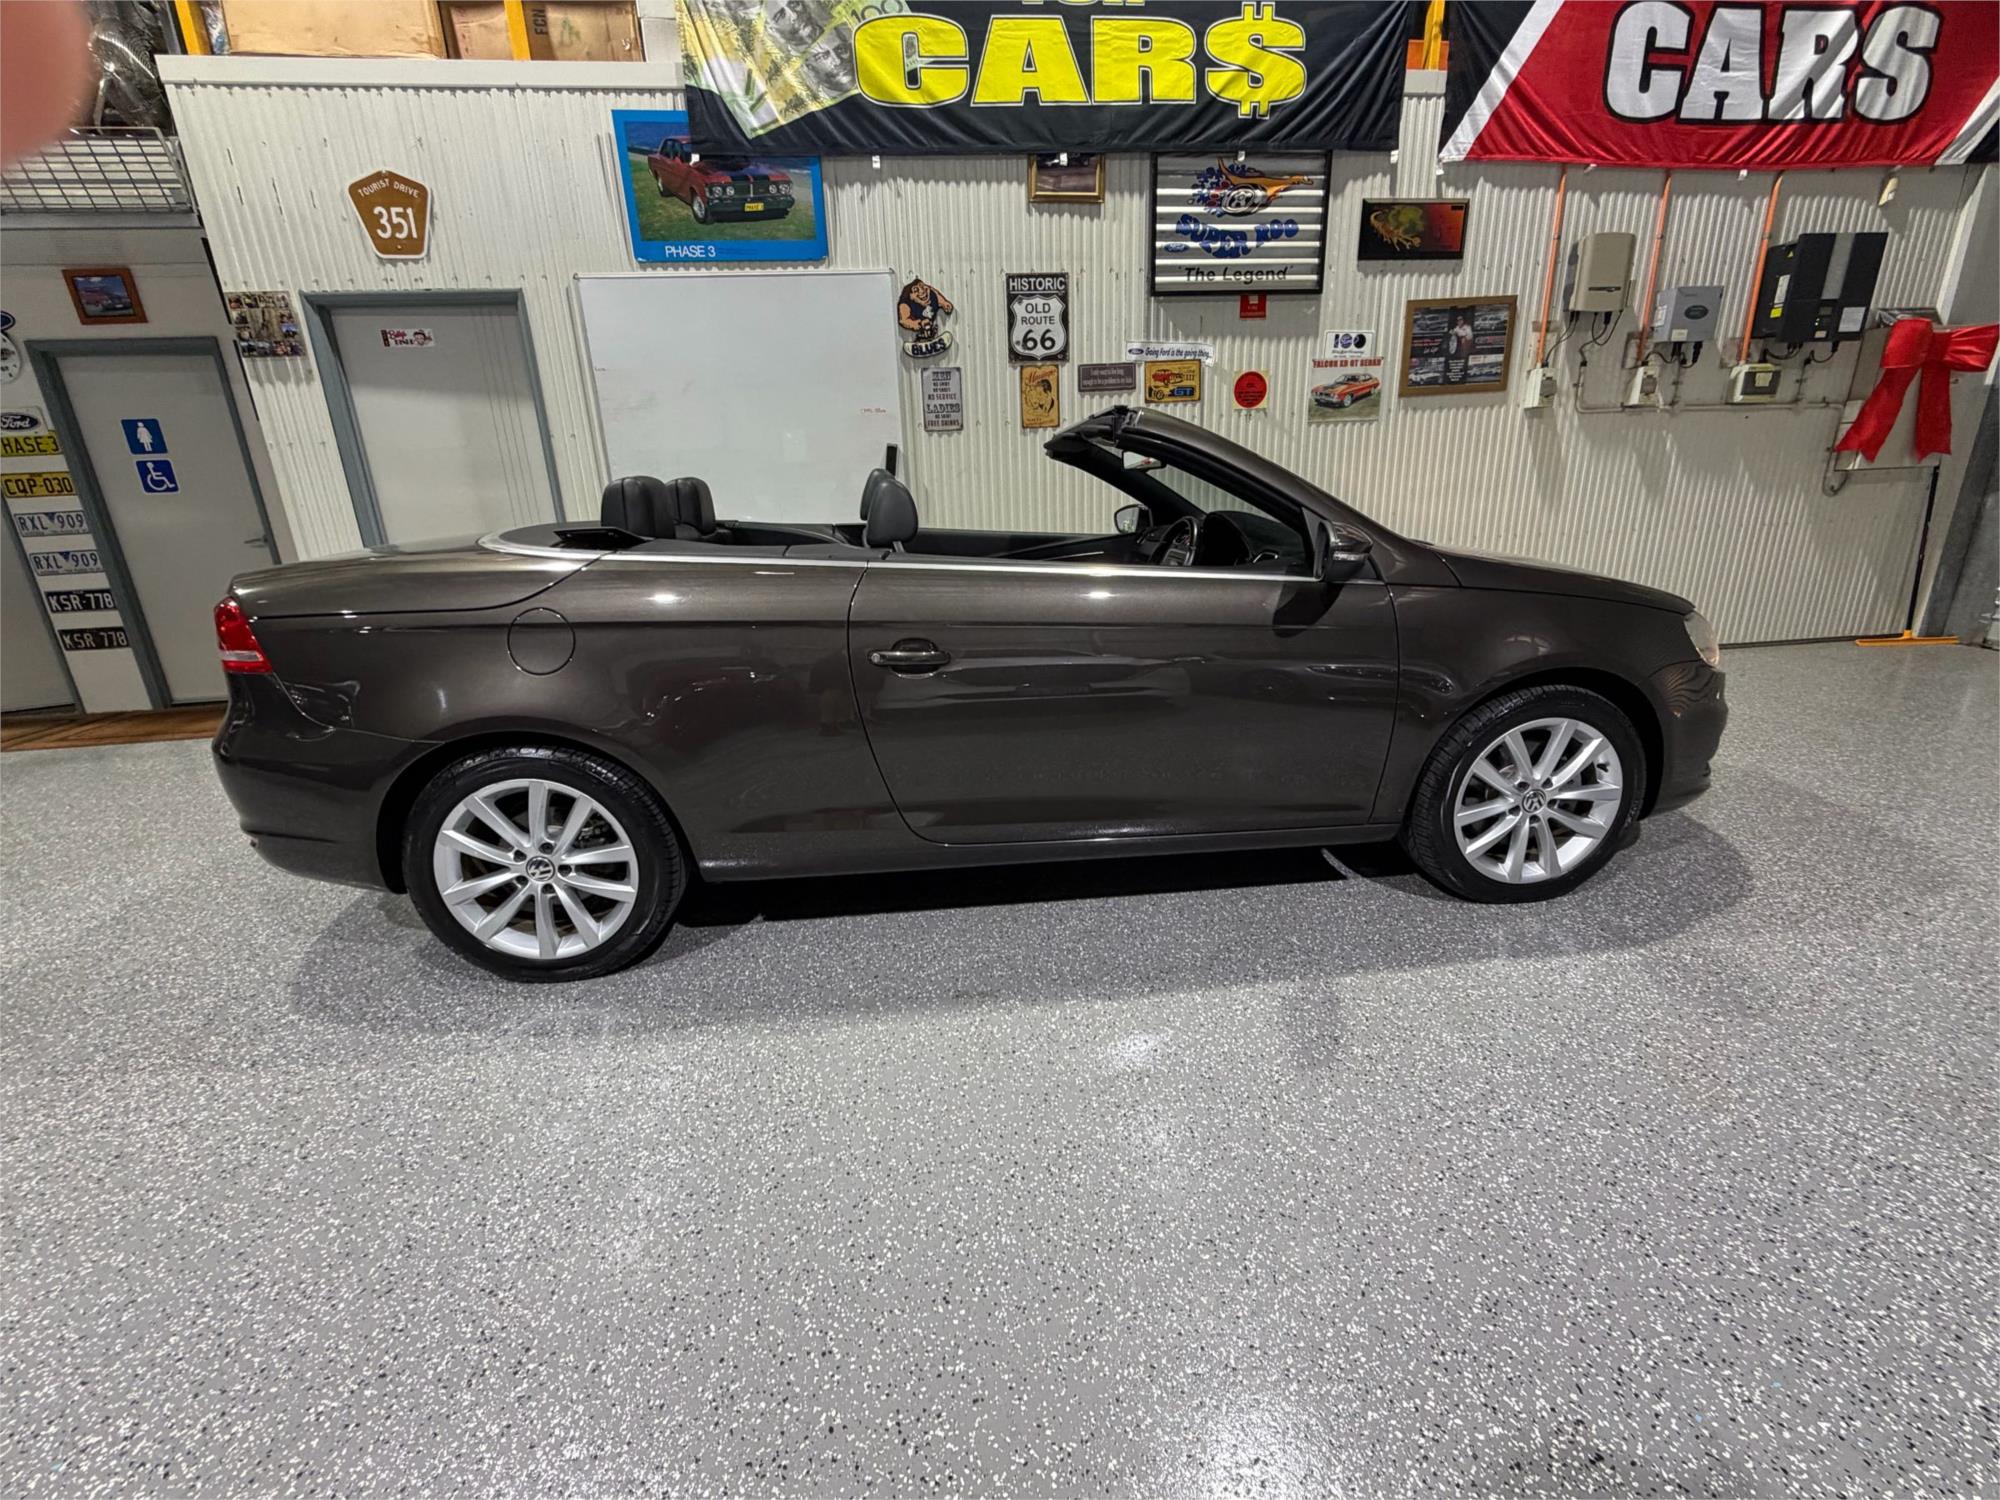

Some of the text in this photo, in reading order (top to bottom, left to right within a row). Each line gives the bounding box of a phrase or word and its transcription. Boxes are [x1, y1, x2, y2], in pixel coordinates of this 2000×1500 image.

[853, 2, 1307, 119] CAR$
[1605, 1, 1942, 122] CARS
[358, 178, 419, 198] TOURIST DRIVE
[373, 206, 418, 239] 351
[665, 246, 716, 259] PHASE 3
[1009, 277, 1065, 291] HISTORIC
[1025, 303, 1051, 314] OLD
[1021, 316, 1055, 325] ROUTE
[912, 337, 946, 356] BLUES
[1022, 329, 1056, 350] 66
[1174, 388, 1193, 396] GT
[927, 403, 960, 413] LADIES
[0, 415, 30, 428] Ford
[18, 513, 84, 531] RXL 909
[33, 552, 98, 570] RXL 909
